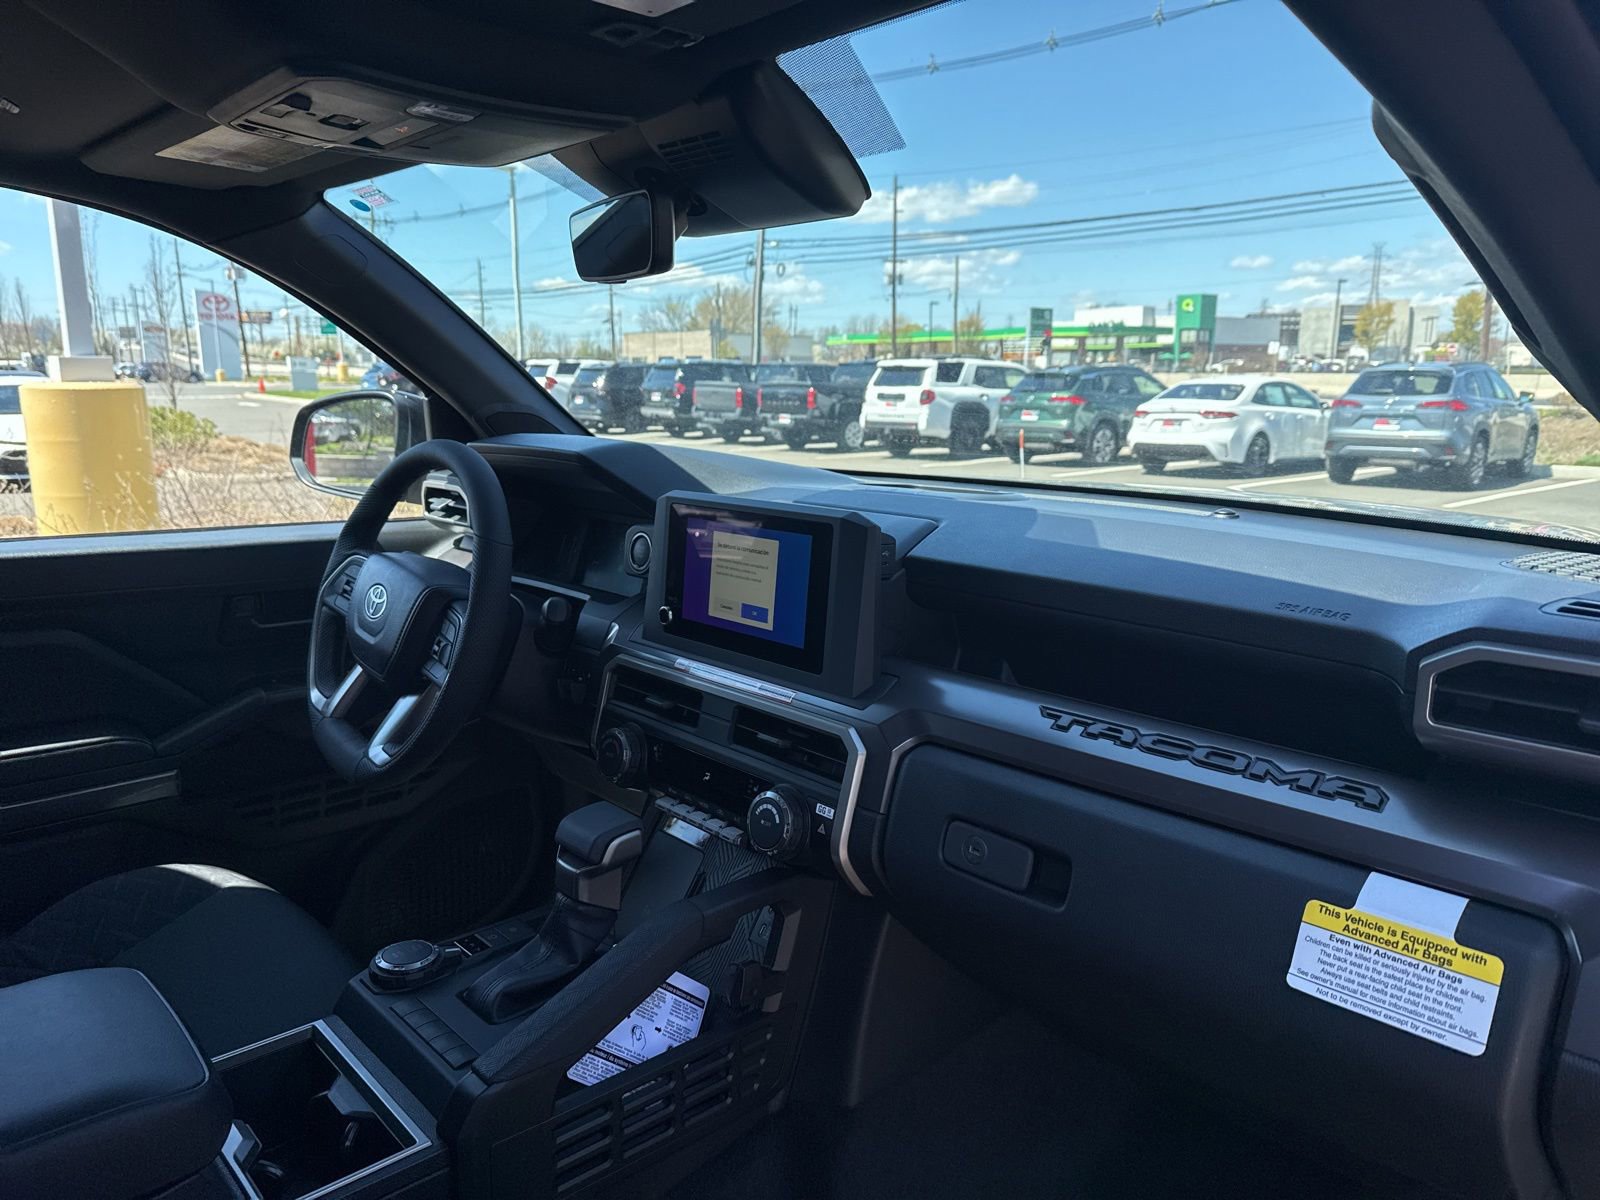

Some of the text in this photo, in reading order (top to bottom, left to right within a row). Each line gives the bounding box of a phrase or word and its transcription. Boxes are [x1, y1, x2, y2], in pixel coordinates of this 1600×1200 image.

[1038, 705, 1391, 814] TACOMA
[1318, 905, 1488, 964] This Vehicle is Equipped with
[1329, 934, 1463, 985] Even with Advanced Air Bags
[1342, 923, 1454, 969] Advanced Air Bags
[1304, 935, 1330, 949] Children
[1354, 952, 1371, 962] killed
[1380, 961, 1410, 977] seriously
[1411, 971, 1435, 986] injured
[1447, 983, 1458, 992] the
[1460, 987, 1469, 996] air
[1470, 991, 1486, 1003] bag.
[1317, 957, 1335, 968] Never
[1336, 964, 1347, 974] put
[1354, 970, 1389, 989] rear-facing
[1390, 982, 1406, 993] child
[1407, 988, 1423, 999] seat
[1431, 997, 1443, 1006] the
[1444, 1001, 1463, 1013] front.
[1319, 949, 1331, 958] The
[1332, 953, 1347, 963] back
[1349, 959, 1363, 969] seat
[1371, 967, 1382, 975] the
[1383, 971, 1403, 983] safest
[1404, 978, 1423, 991] place
[1425, 985, 1433, 993] for
[1436, 988, 1465, 1004] children.
[1320, 967, 1342, 981] Always
[1356, 980, 1370, 990] seat
[1372, 985, 1388, 996] belts
[1389, 992, 1402, 1001] and
[1403, 997, 1419, 1007] child
[1421, 1003, 1455, 1020] restraints.
[1296, 968, 1478, 1040] See owner's manual for more information about air bags.
[1316, 987, 1329, 997] Not
[1350, 1000, 1381, 1016] removed
[1382, 1012, 1408, 1028] except
[1421, 1027, 1447, 1041] owner.
